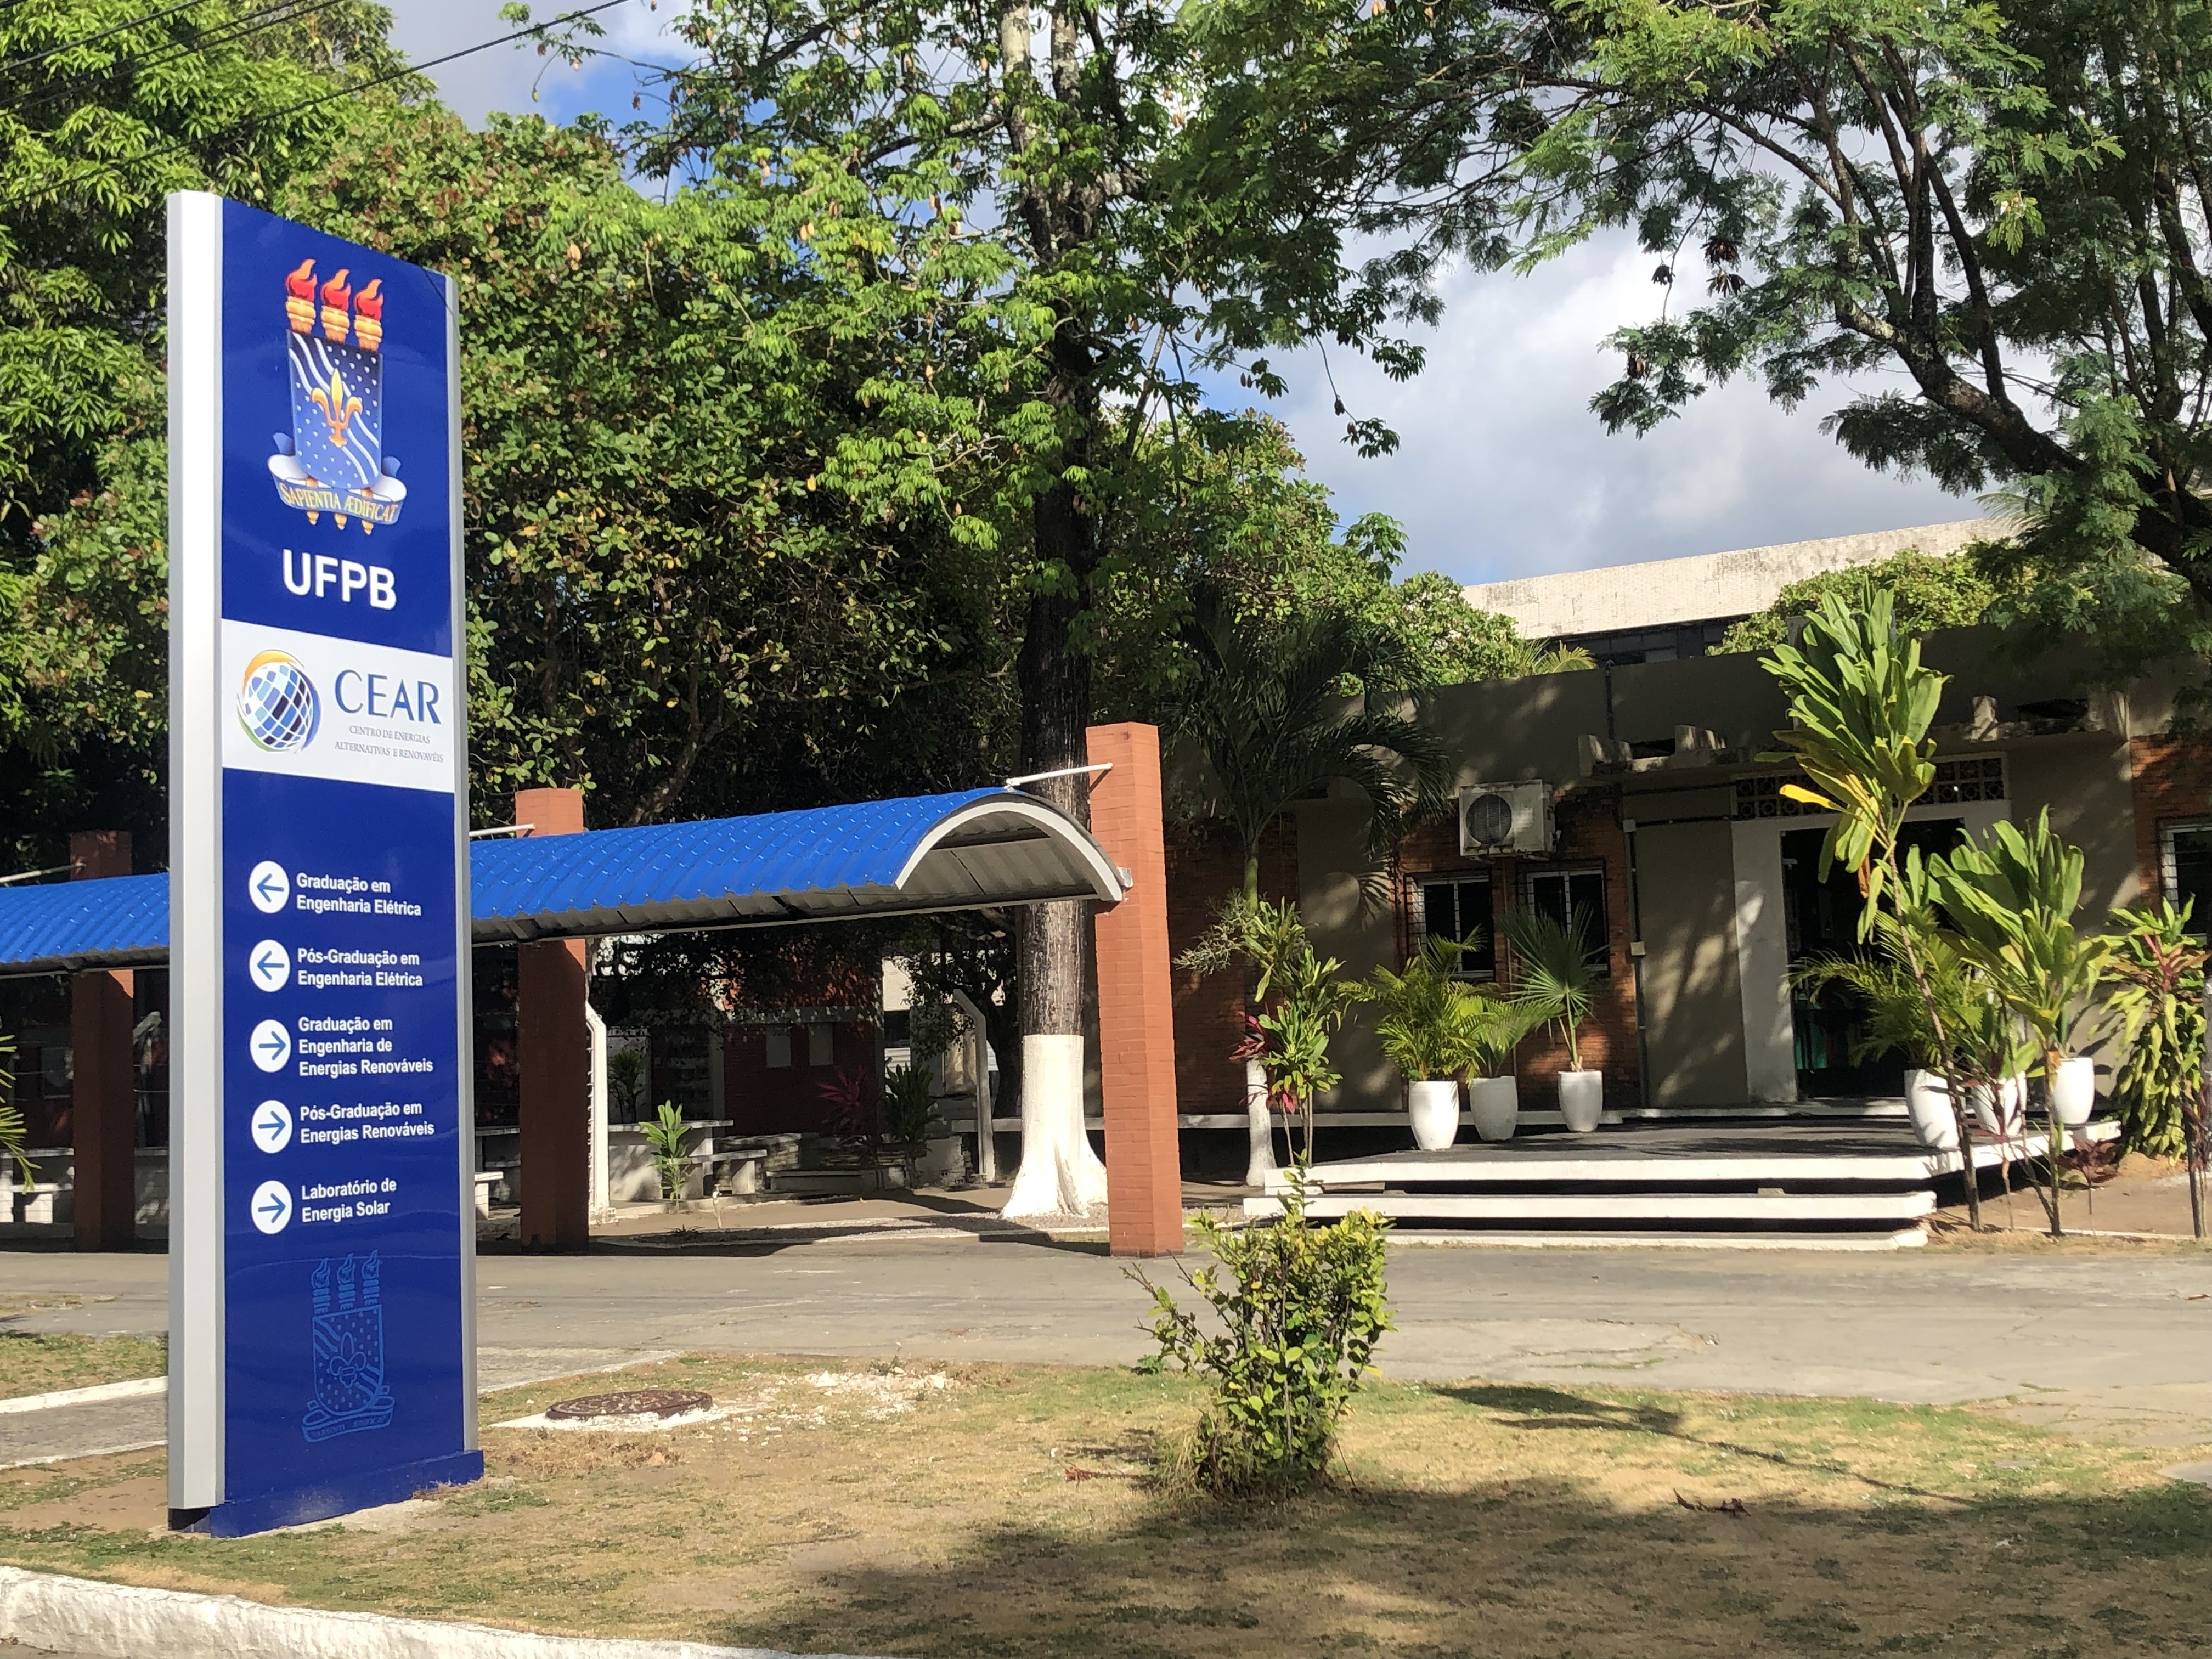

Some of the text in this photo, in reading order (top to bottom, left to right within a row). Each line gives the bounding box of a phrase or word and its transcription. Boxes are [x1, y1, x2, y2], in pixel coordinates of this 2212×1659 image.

[279, 482, 341, 510] SAPIENTIA
[283, 548, 397, 611] UFPB
[335, 669, 442, 725] CEAR
[349, 725, 431, 744] CENTRO DE ENERGIAS
[335, 741, 391, 756] ALTERNATIVAS
[393, 748, 398, 757] E
[296, 872, 391, 894] Graduação em
[296, 894, 422, 916] Engenharia Elétrica
[297, 947, 420, 968] Pós-Graduação em
[297, 970, 423, 989] Engenharia Elétrica
[298, 1016, 393, 1035] Graduação em
[298, 1038, 392, 1058] Engenharia de
[299, 1058, 434, 1079] Energias Renováveis
[300, 1102, 422, 1121] Pós-Graduação em
[300, 1120, 435, 1145] Energias Renováveis
[302, 1177, 397, 1200] Laboratório de
[302, 1201, 391, 1223] Energia Solar
